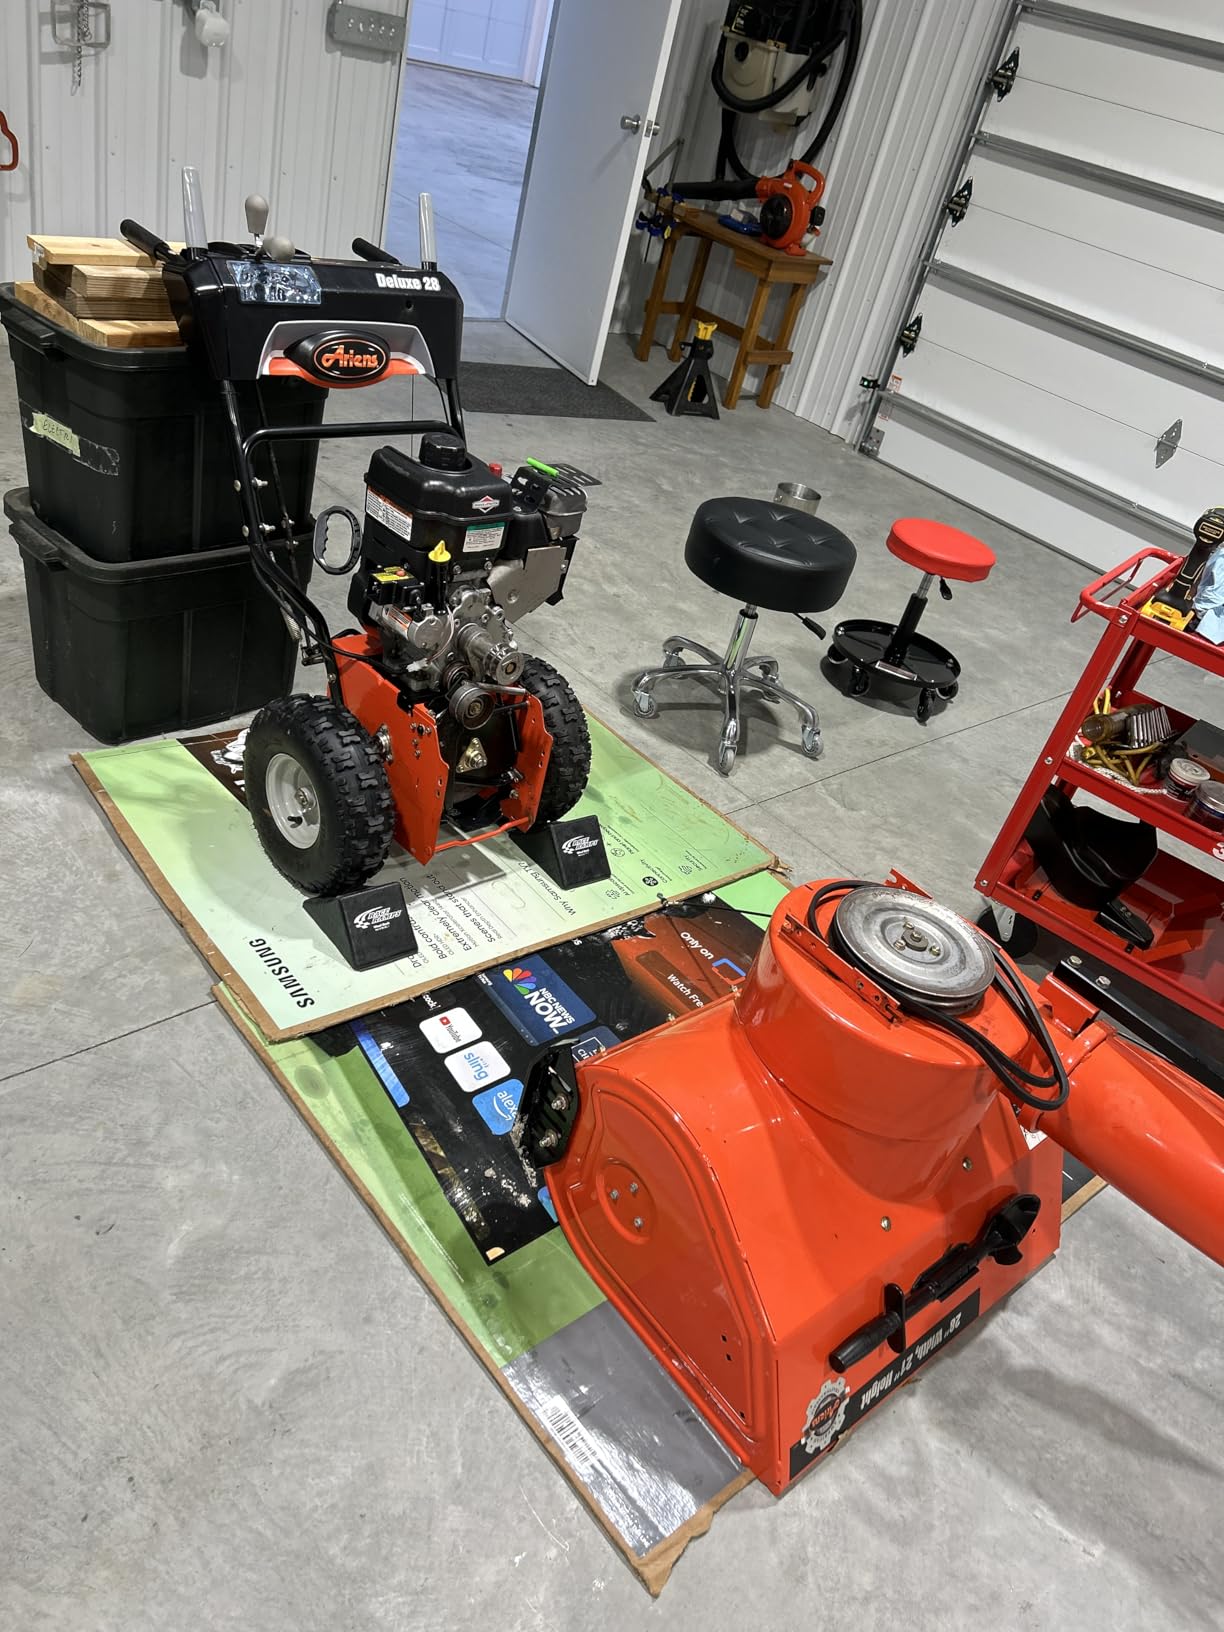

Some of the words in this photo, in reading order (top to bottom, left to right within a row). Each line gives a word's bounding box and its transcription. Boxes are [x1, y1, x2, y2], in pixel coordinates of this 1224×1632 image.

[375, 273, 422, 290] Deluxe
[422, 276, 441, 291] 28
[321, 344, 379, 368] Ariens
[518, 860, 532, 873] TV?
[400, 877, 424, 899] motion
[426, 874, 440, 886] out
[531, 871, 562, 901] Samsung
[439, 885, 459, 904] stand
[367, 907, 391, 920] RACE
[420, 899, 440, 916] clear
[456, 903, 472, 918] that
[560, 900, 576, 916] Why
[409, 916, 433, 944] contra
[439, 916, 472, 952] Extremely
[470, 917, 496, 943] Scenes
[432, 943, 448, 960] Bold
[680, 931, 703, 949] Only
[699, 948, 715, 960] on
[249, 938, 315, 1008] SAMSUNG
[422, 992, 437, 1010] cock
[667, 973, 691, 996] Watch
[689, 994, 704, 1009] Fre
[539, 987, 557, 1004] NBC
[552, 1001, 576, 1024] NEWS
[444, 1023, 463, 1043] YouTube
[463, 1051, 489, 1081] sling
[860, 1370, 894, 1410] Height
[811, 1398, 841, 1428] Ariens
